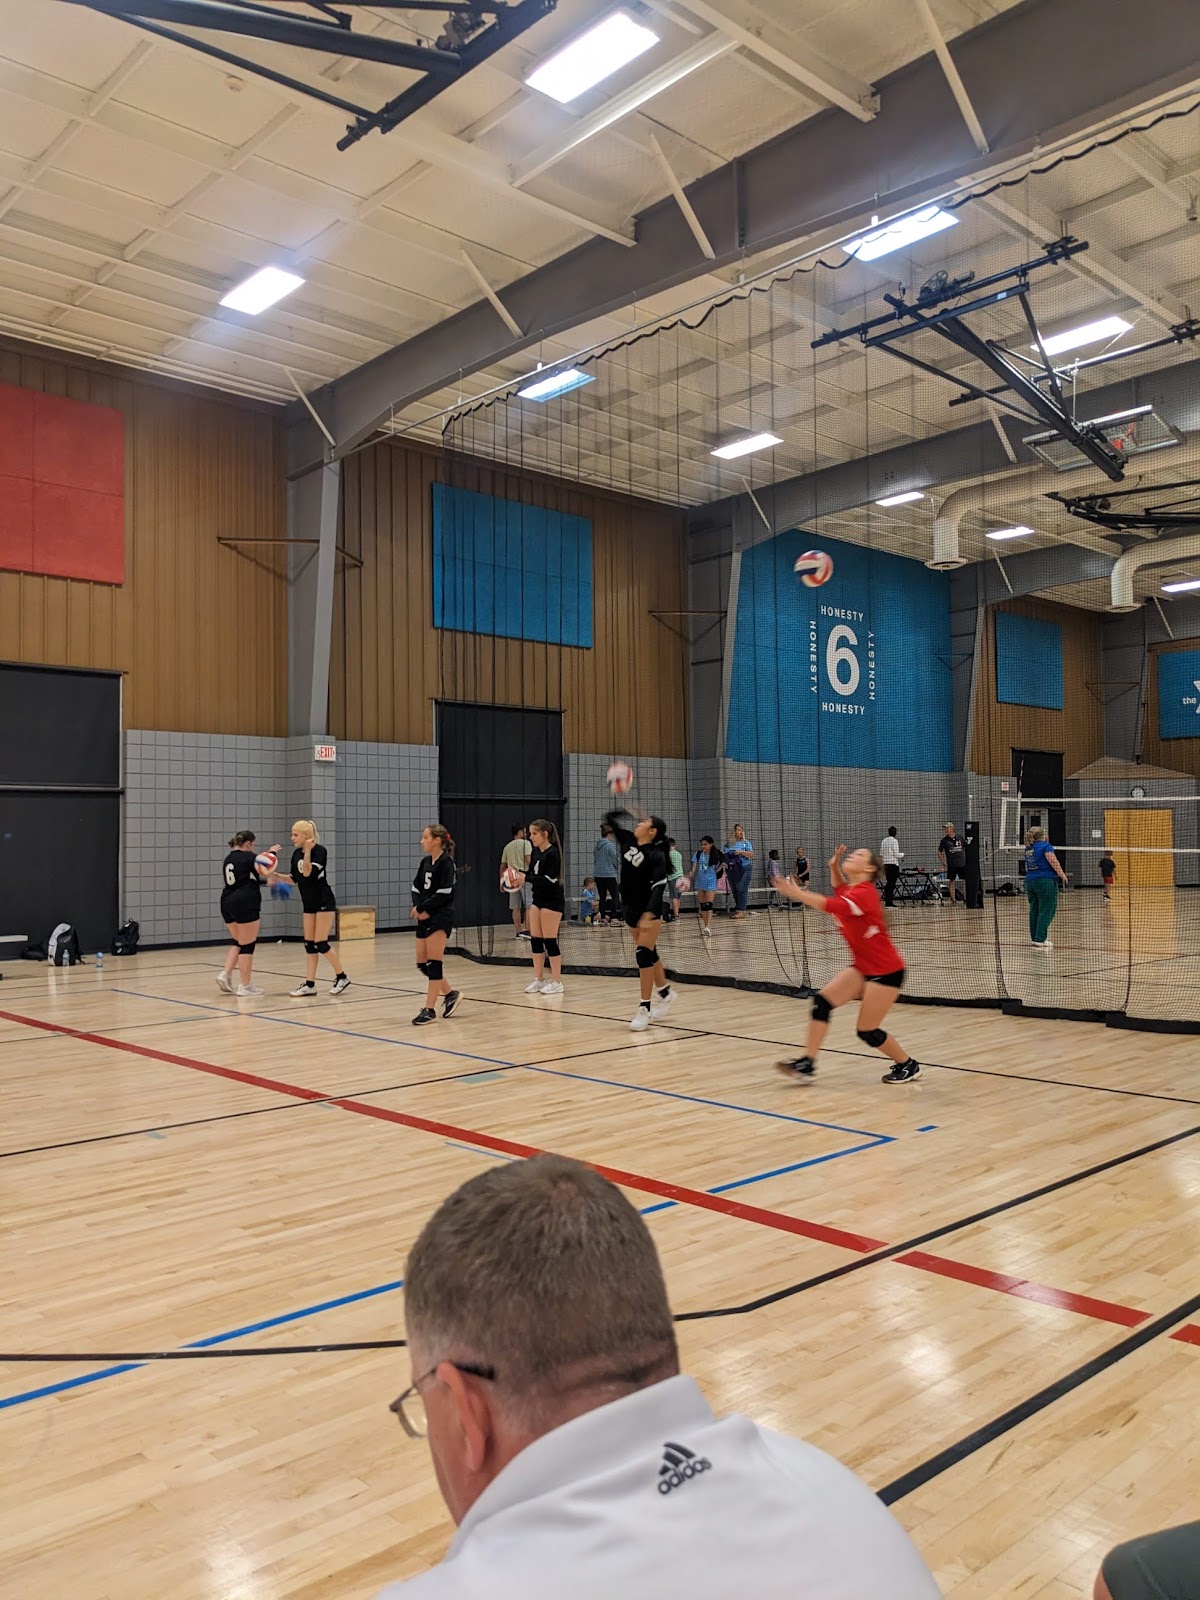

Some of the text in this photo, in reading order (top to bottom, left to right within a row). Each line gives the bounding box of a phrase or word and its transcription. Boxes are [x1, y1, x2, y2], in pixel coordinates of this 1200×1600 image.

[821, 605, 864, 622] HONESTY
[810, 620, 818, 693] HONESTY
[826, 624, 860, 696] 6
[868, 631, 876, 700] HONESTY
[822, 702, 865, 715] HONESTY
[320, 746, 334, 758] EXIT
[624, 846, 645, 868] 20
[225, 863, 236, 886] 6
[424, 872, 433, 890] 5
[658, 1457, 712, 1495] adidas
